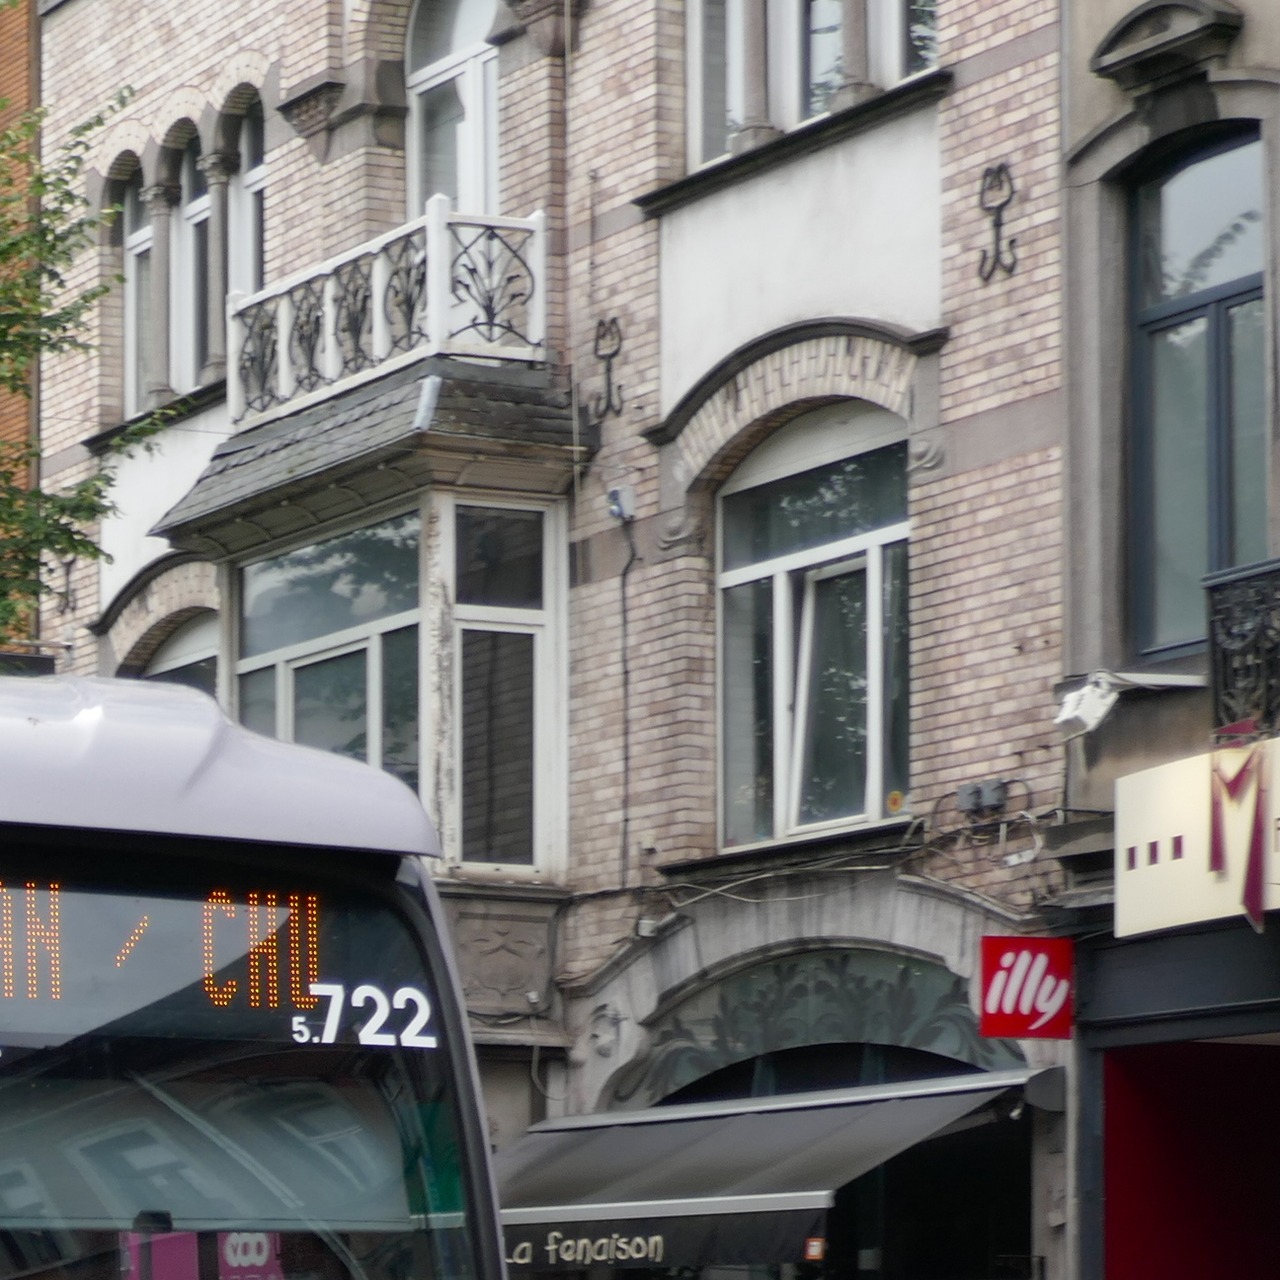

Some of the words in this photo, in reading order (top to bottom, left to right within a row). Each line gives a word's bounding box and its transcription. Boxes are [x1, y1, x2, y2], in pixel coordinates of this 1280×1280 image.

[203, 890, 319, 1009] CHU
[985, 949, 1070, 1030] illy
[545, 1231, 664, 1265] fenaison
